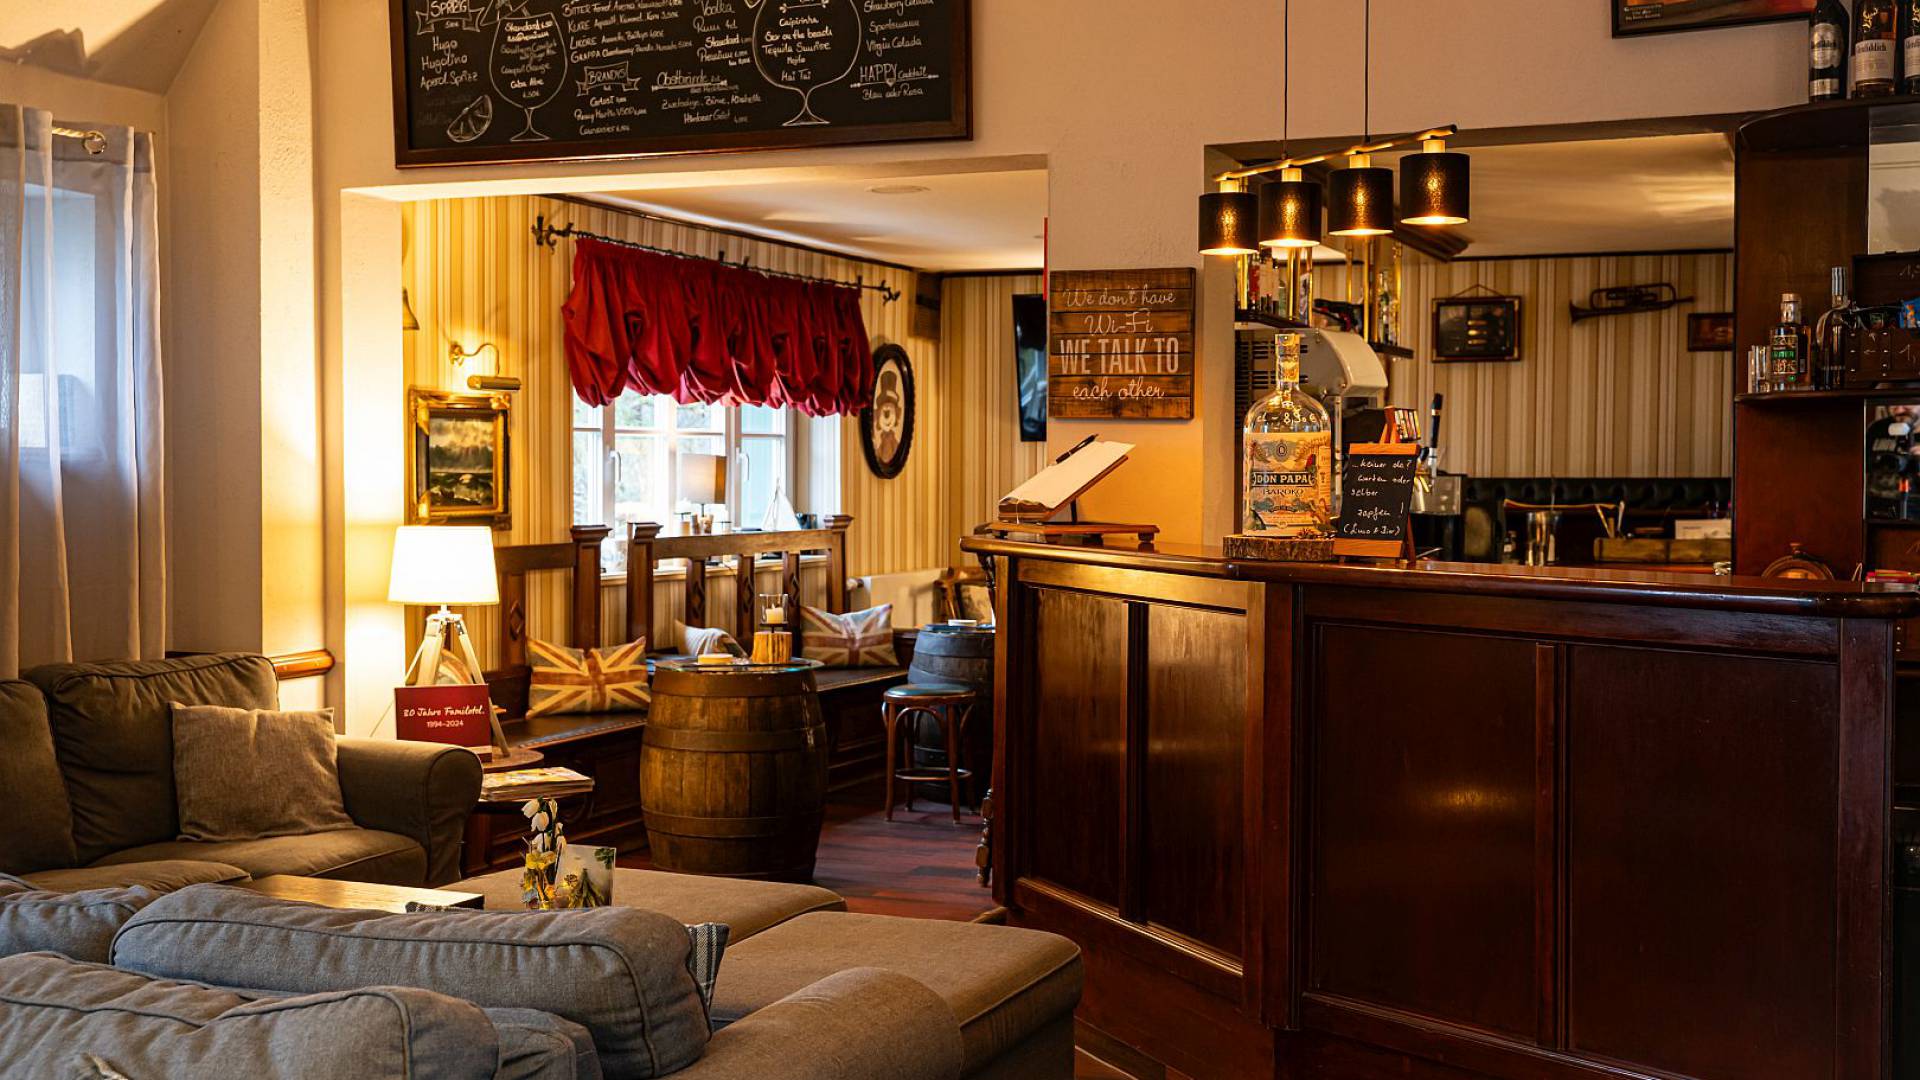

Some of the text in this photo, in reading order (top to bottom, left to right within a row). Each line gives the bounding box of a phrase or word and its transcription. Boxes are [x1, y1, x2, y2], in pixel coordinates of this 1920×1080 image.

[561, 2, 591, 17] BITTER
[432, 36, 458, 56] Hugo
[891, 34, 922, 49] Colada
[860, 63, 897, 83] HAPPY
[1099, 285, 1138, 306] don't
[1141, 284, 1176, 306] have
[1084, 308, 1154, 337] Wi-Fi
[1060, 337, 1179, 375] WE TALK TO
[1072, 376, 1112, 401] each
[1256, 474, 1308, 484] DON PAPA
[417, 707, 441, 717] Jahre
[426, 720, 464, 728] 1994-2024
